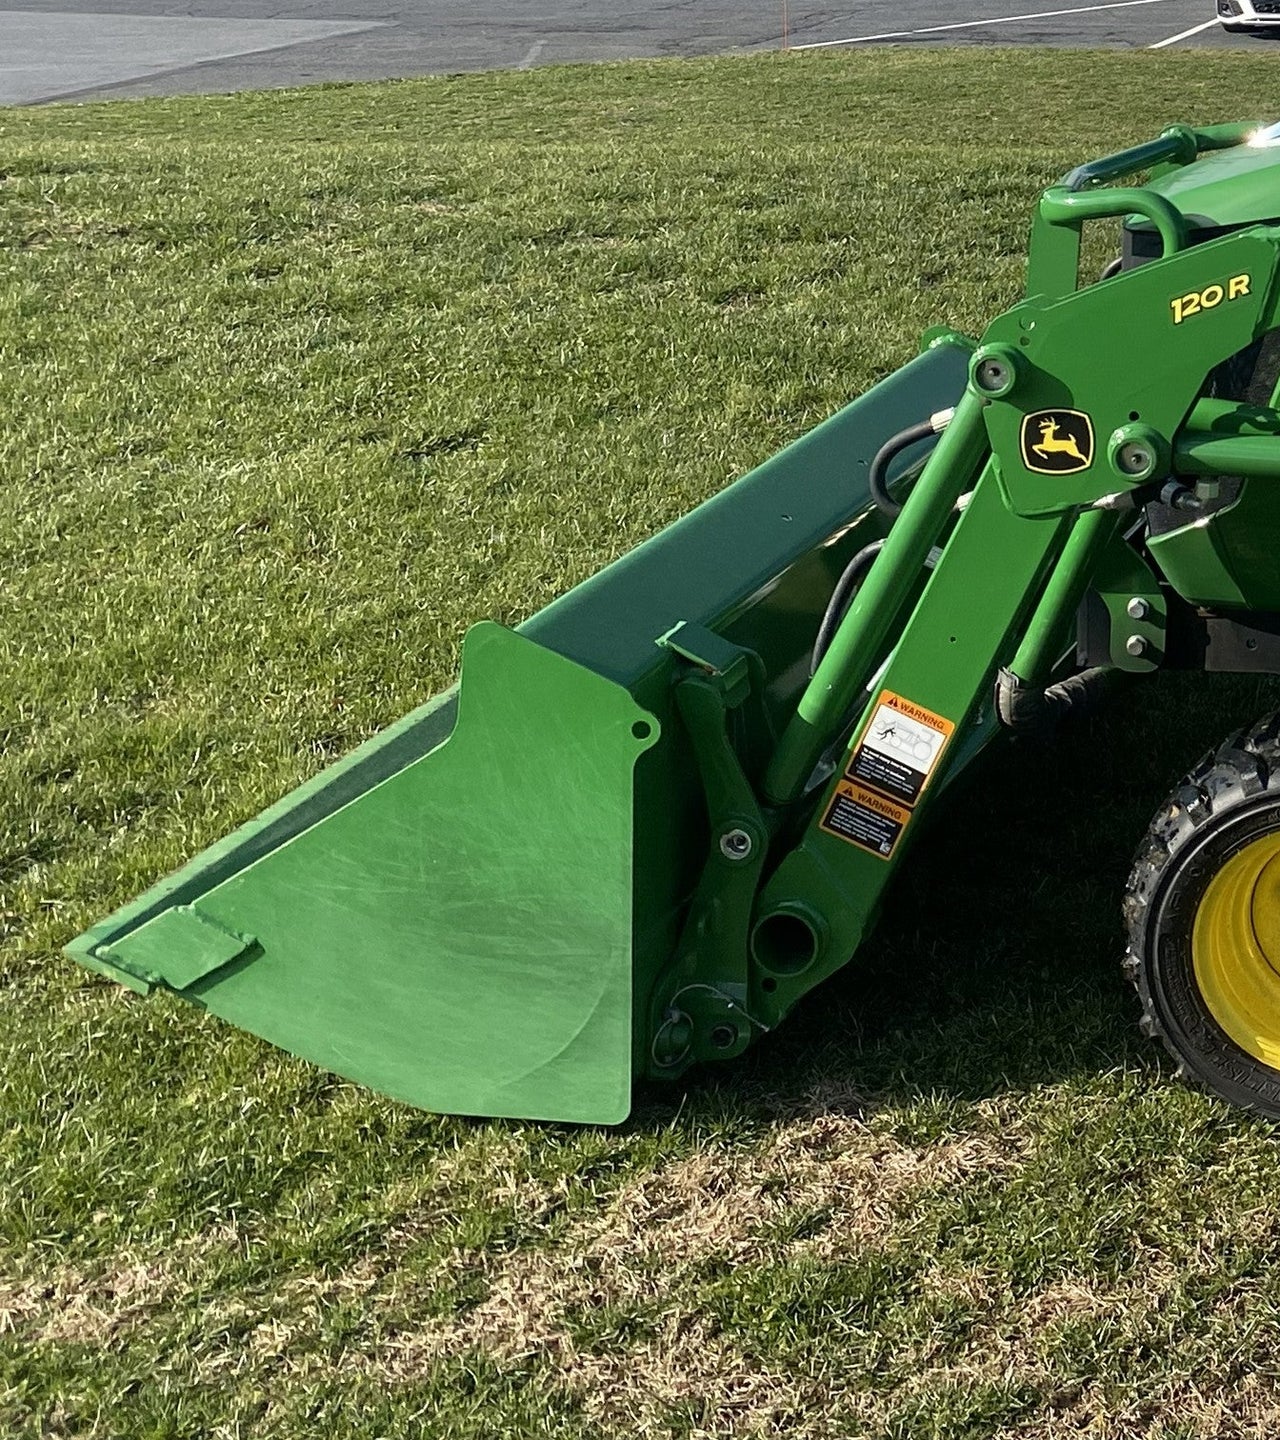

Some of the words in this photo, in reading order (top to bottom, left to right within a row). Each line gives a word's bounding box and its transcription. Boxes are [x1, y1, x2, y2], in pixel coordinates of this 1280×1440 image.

[1170, 284, 1224, 325] 120
[1228, 274, 1252, 300] R
[899, 701, 945, 730] WARNING
[857, 791, 903, 820] WARNING
